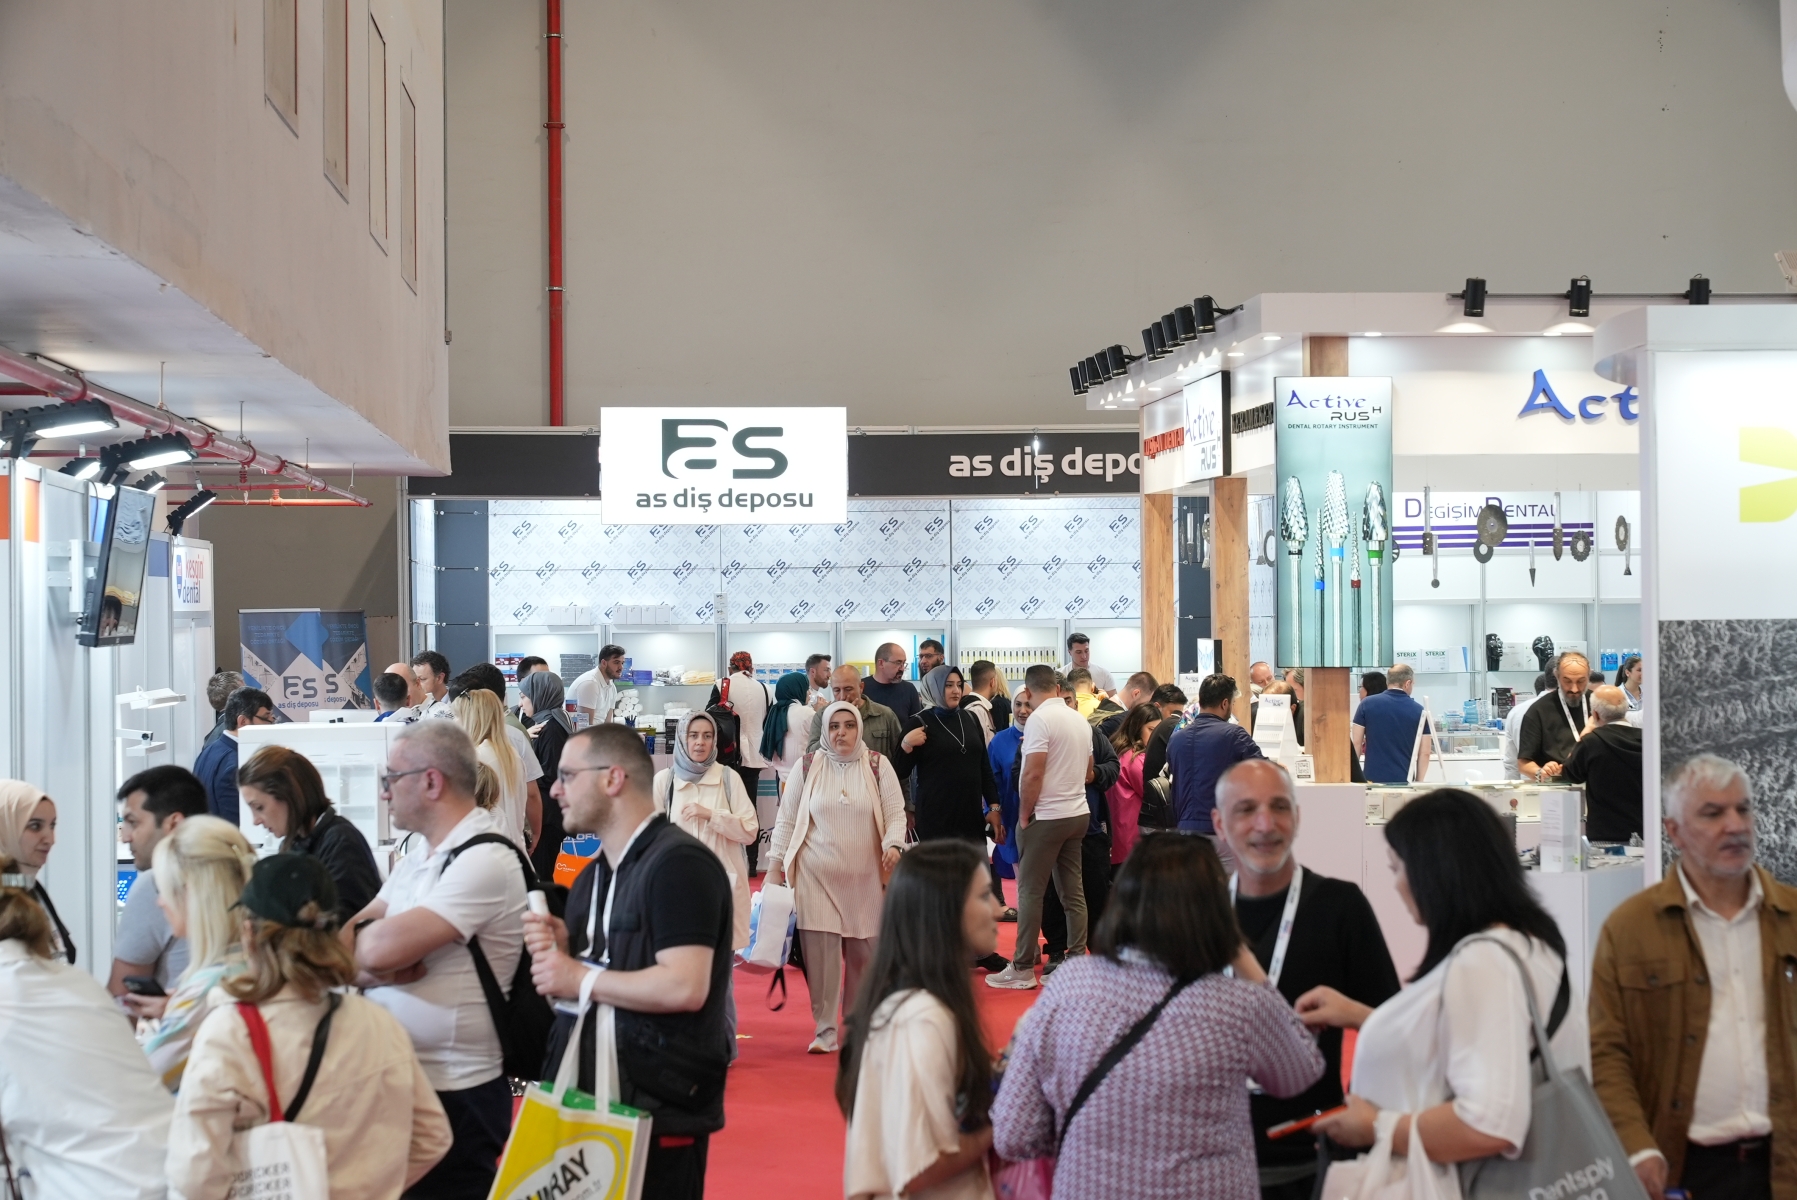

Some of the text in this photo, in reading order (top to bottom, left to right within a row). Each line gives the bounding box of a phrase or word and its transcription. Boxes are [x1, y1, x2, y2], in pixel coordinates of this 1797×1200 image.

[1286, 390, 1366, 408] Active
[1185, 398, 1215, 442] Active
[948, 454, 993, 478] as
[1000, 446, 1054, 484] diş
[636, 487, 813, 513] as diş deposu
[182, 579, 200, 603] dental
[287, 701, 296, 709] diş
